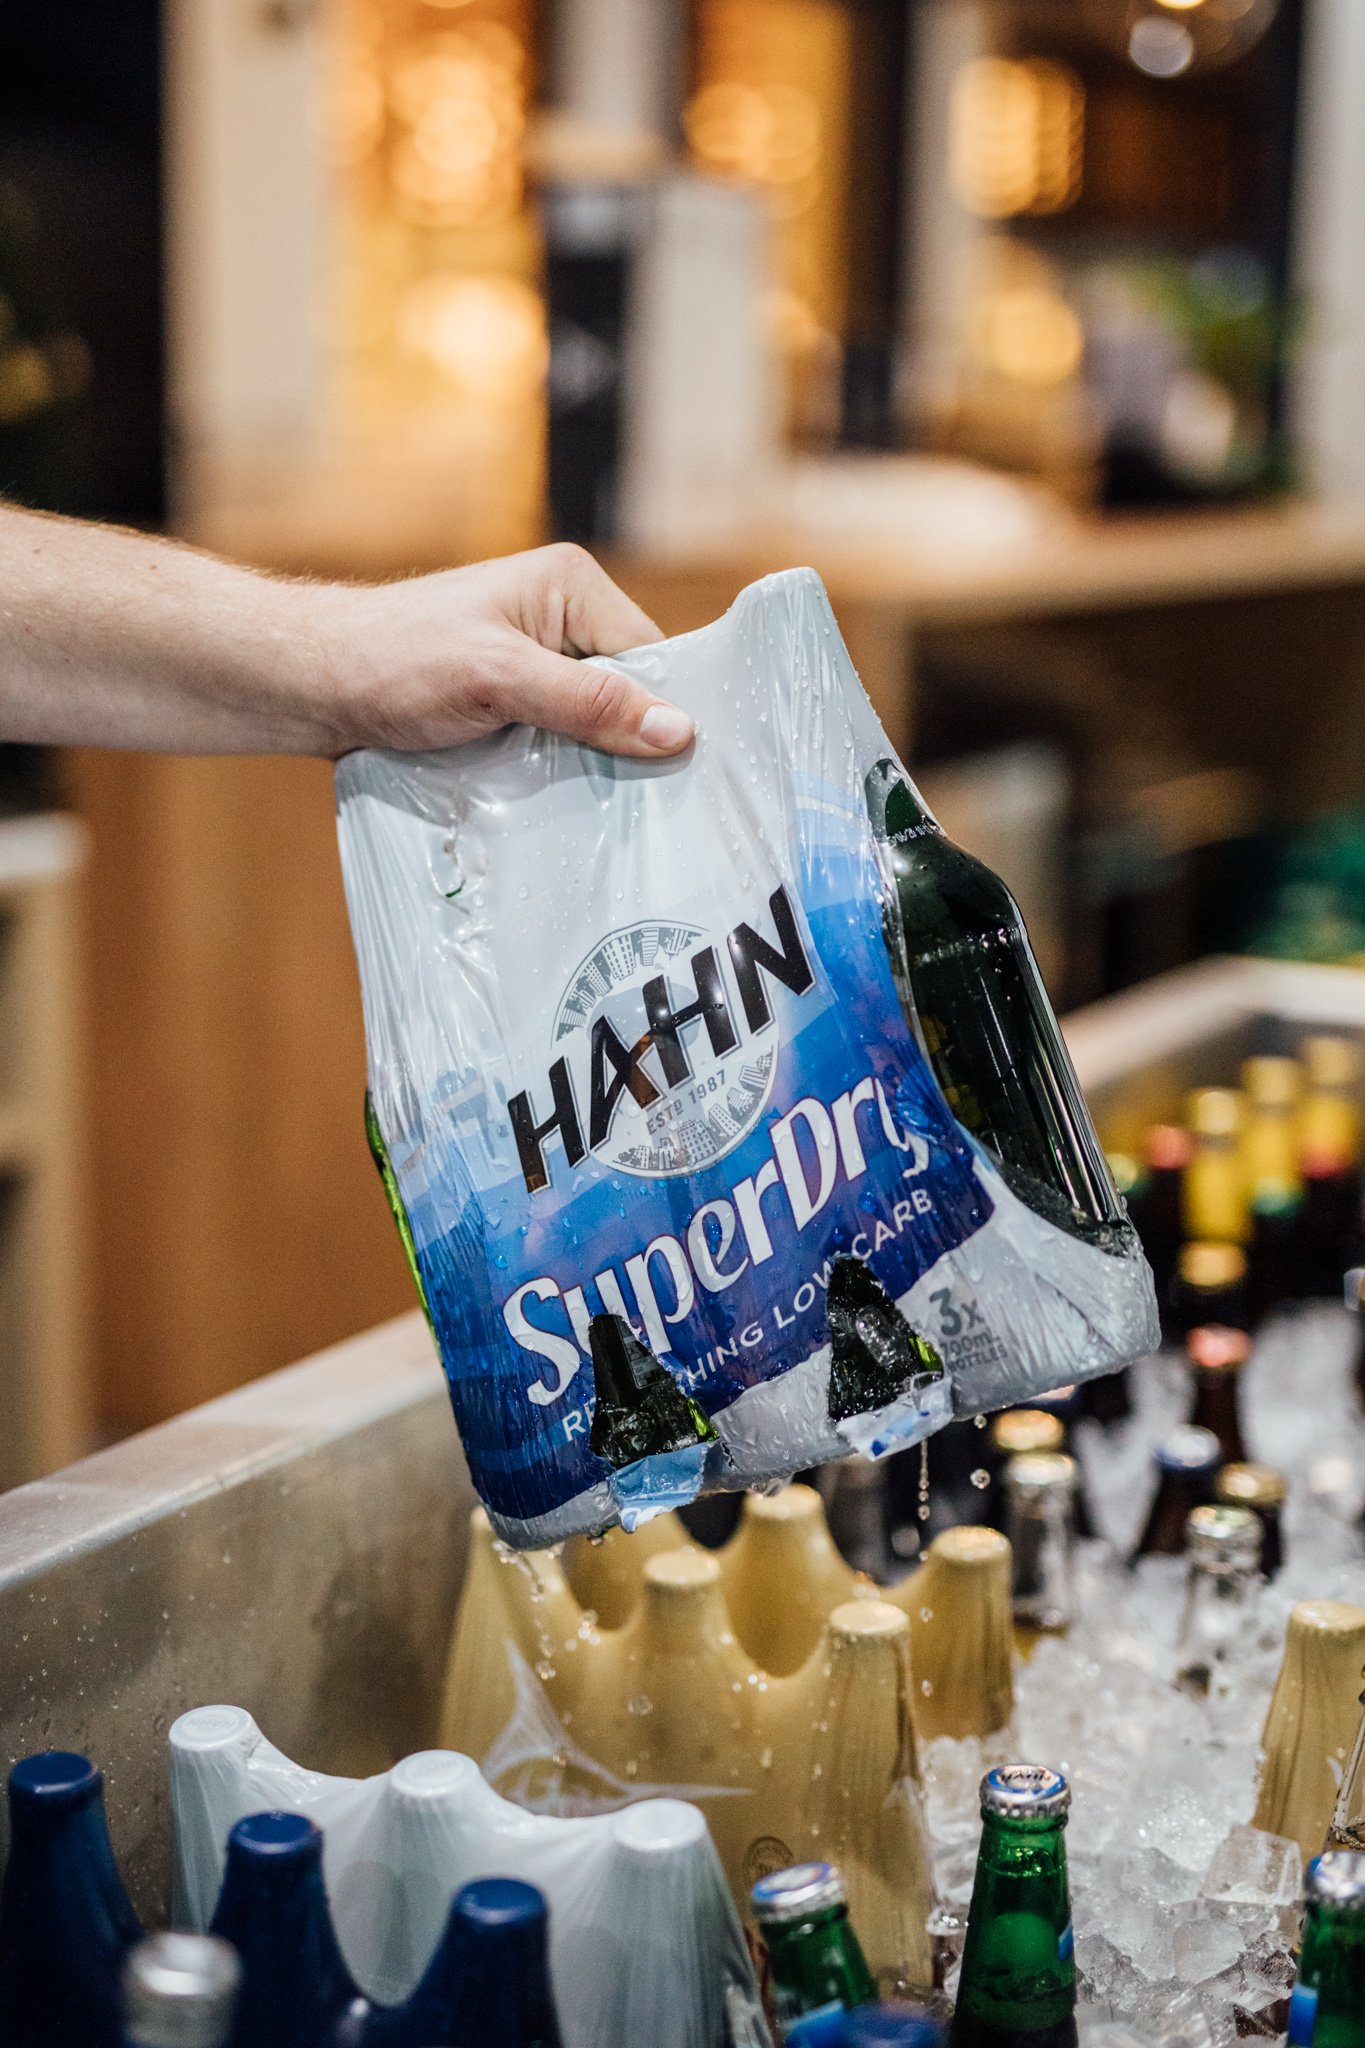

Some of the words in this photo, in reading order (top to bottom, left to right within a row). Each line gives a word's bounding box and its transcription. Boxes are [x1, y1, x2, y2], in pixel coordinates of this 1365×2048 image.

[507, 883, 817, 1194] HAHN
[647, 1100, 684, 1135] ESTD
[688, 1069, 727, 1105] 1987
[503, 1077, 930, 1406] SuperDry
[852, 1189, 932, 1261] CARB
